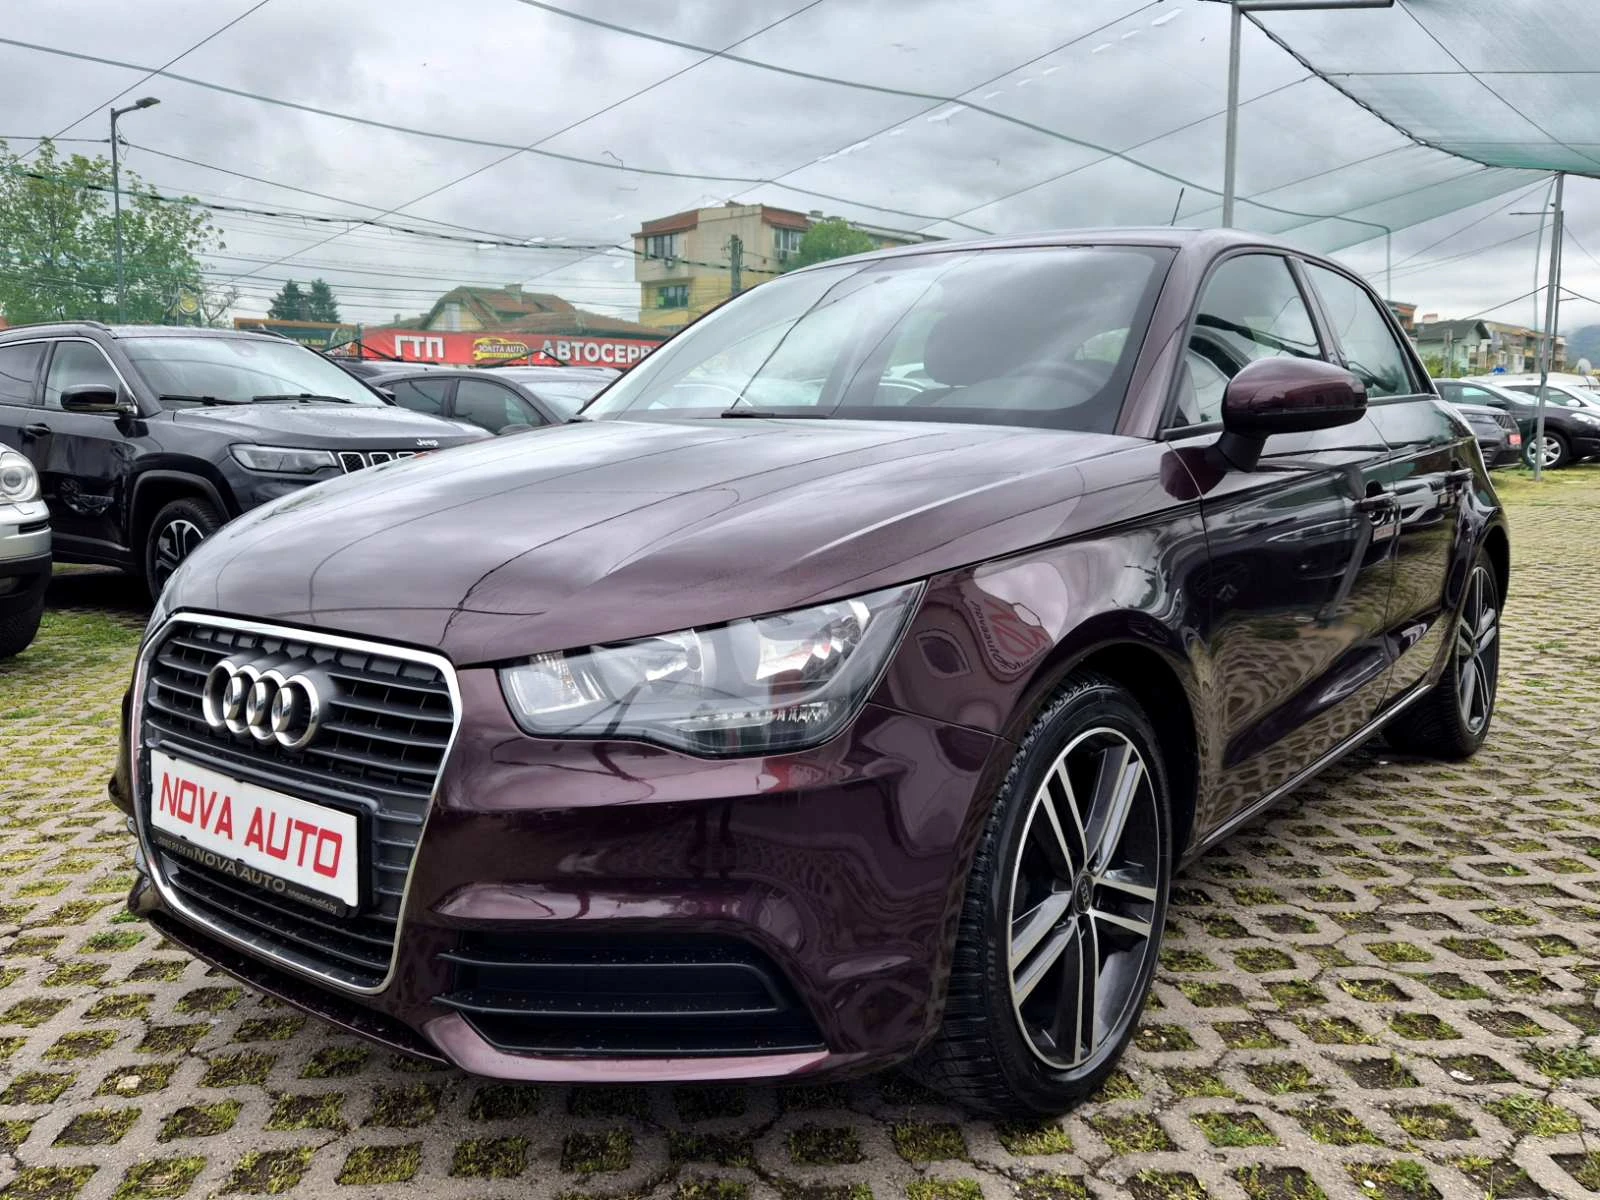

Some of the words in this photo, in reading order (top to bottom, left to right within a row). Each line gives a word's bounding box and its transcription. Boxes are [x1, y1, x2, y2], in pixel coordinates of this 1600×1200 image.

[395, 335, 444, 358] ГТП
[505, 345, 526, 353] AUTO
[416, 438, 439, 448] Jeep
[159, 771, 234, 840] NOVA
[244, 806, 343, 879] AUTO
[194, 847, 238, 877] NOVA
[239, 865, 286, 893] AUTO
